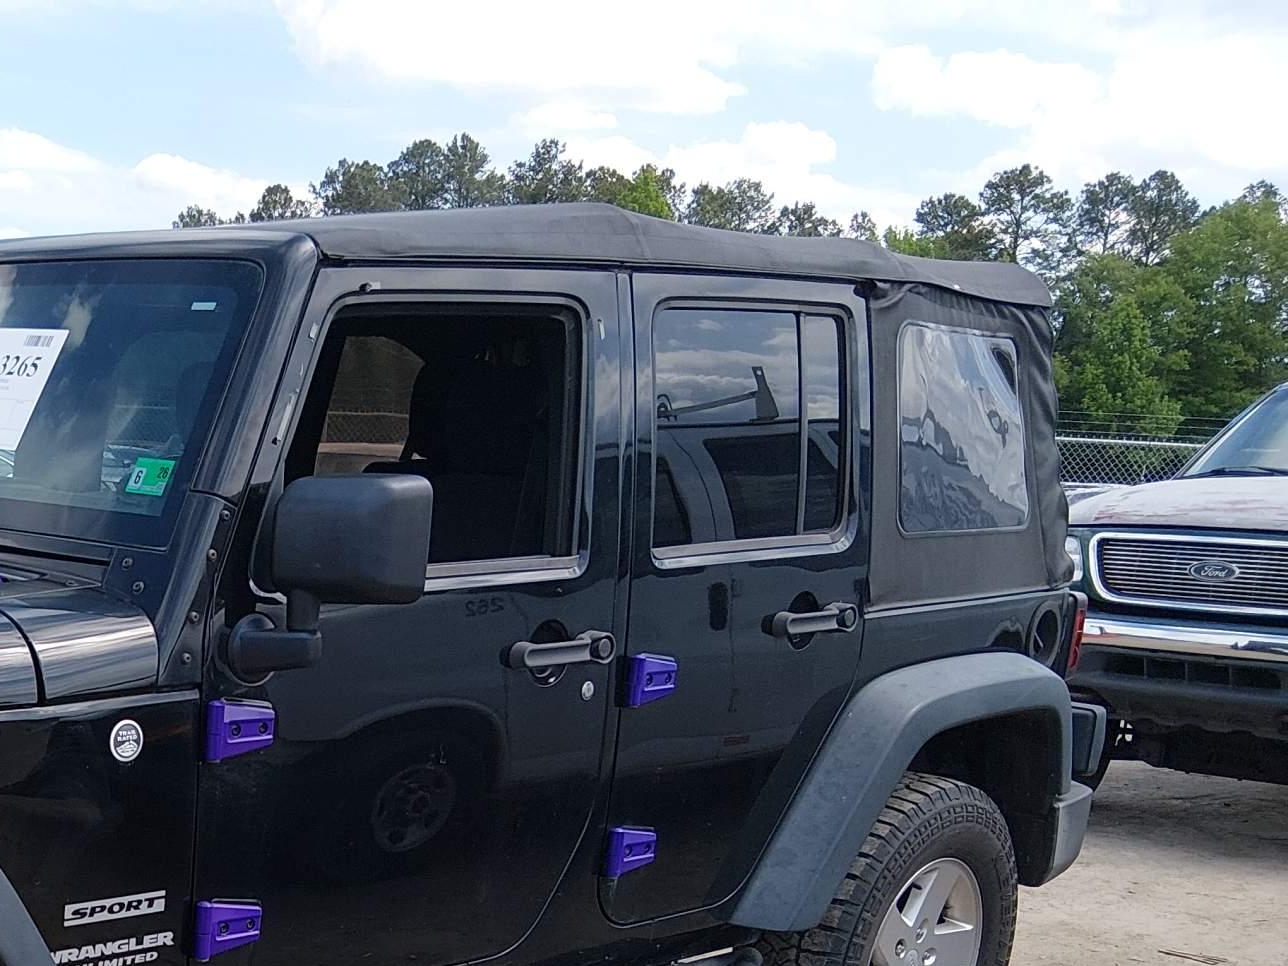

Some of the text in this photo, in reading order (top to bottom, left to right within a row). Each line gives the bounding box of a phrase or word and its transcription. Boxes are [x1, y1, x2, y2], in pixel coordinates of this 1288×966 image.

[134, 470, 144, 485] 6
[157, 466, 170, 479] 26
[1200, 565, 1229, 578] Ford
[70, 896, 157, 921] SPORT
